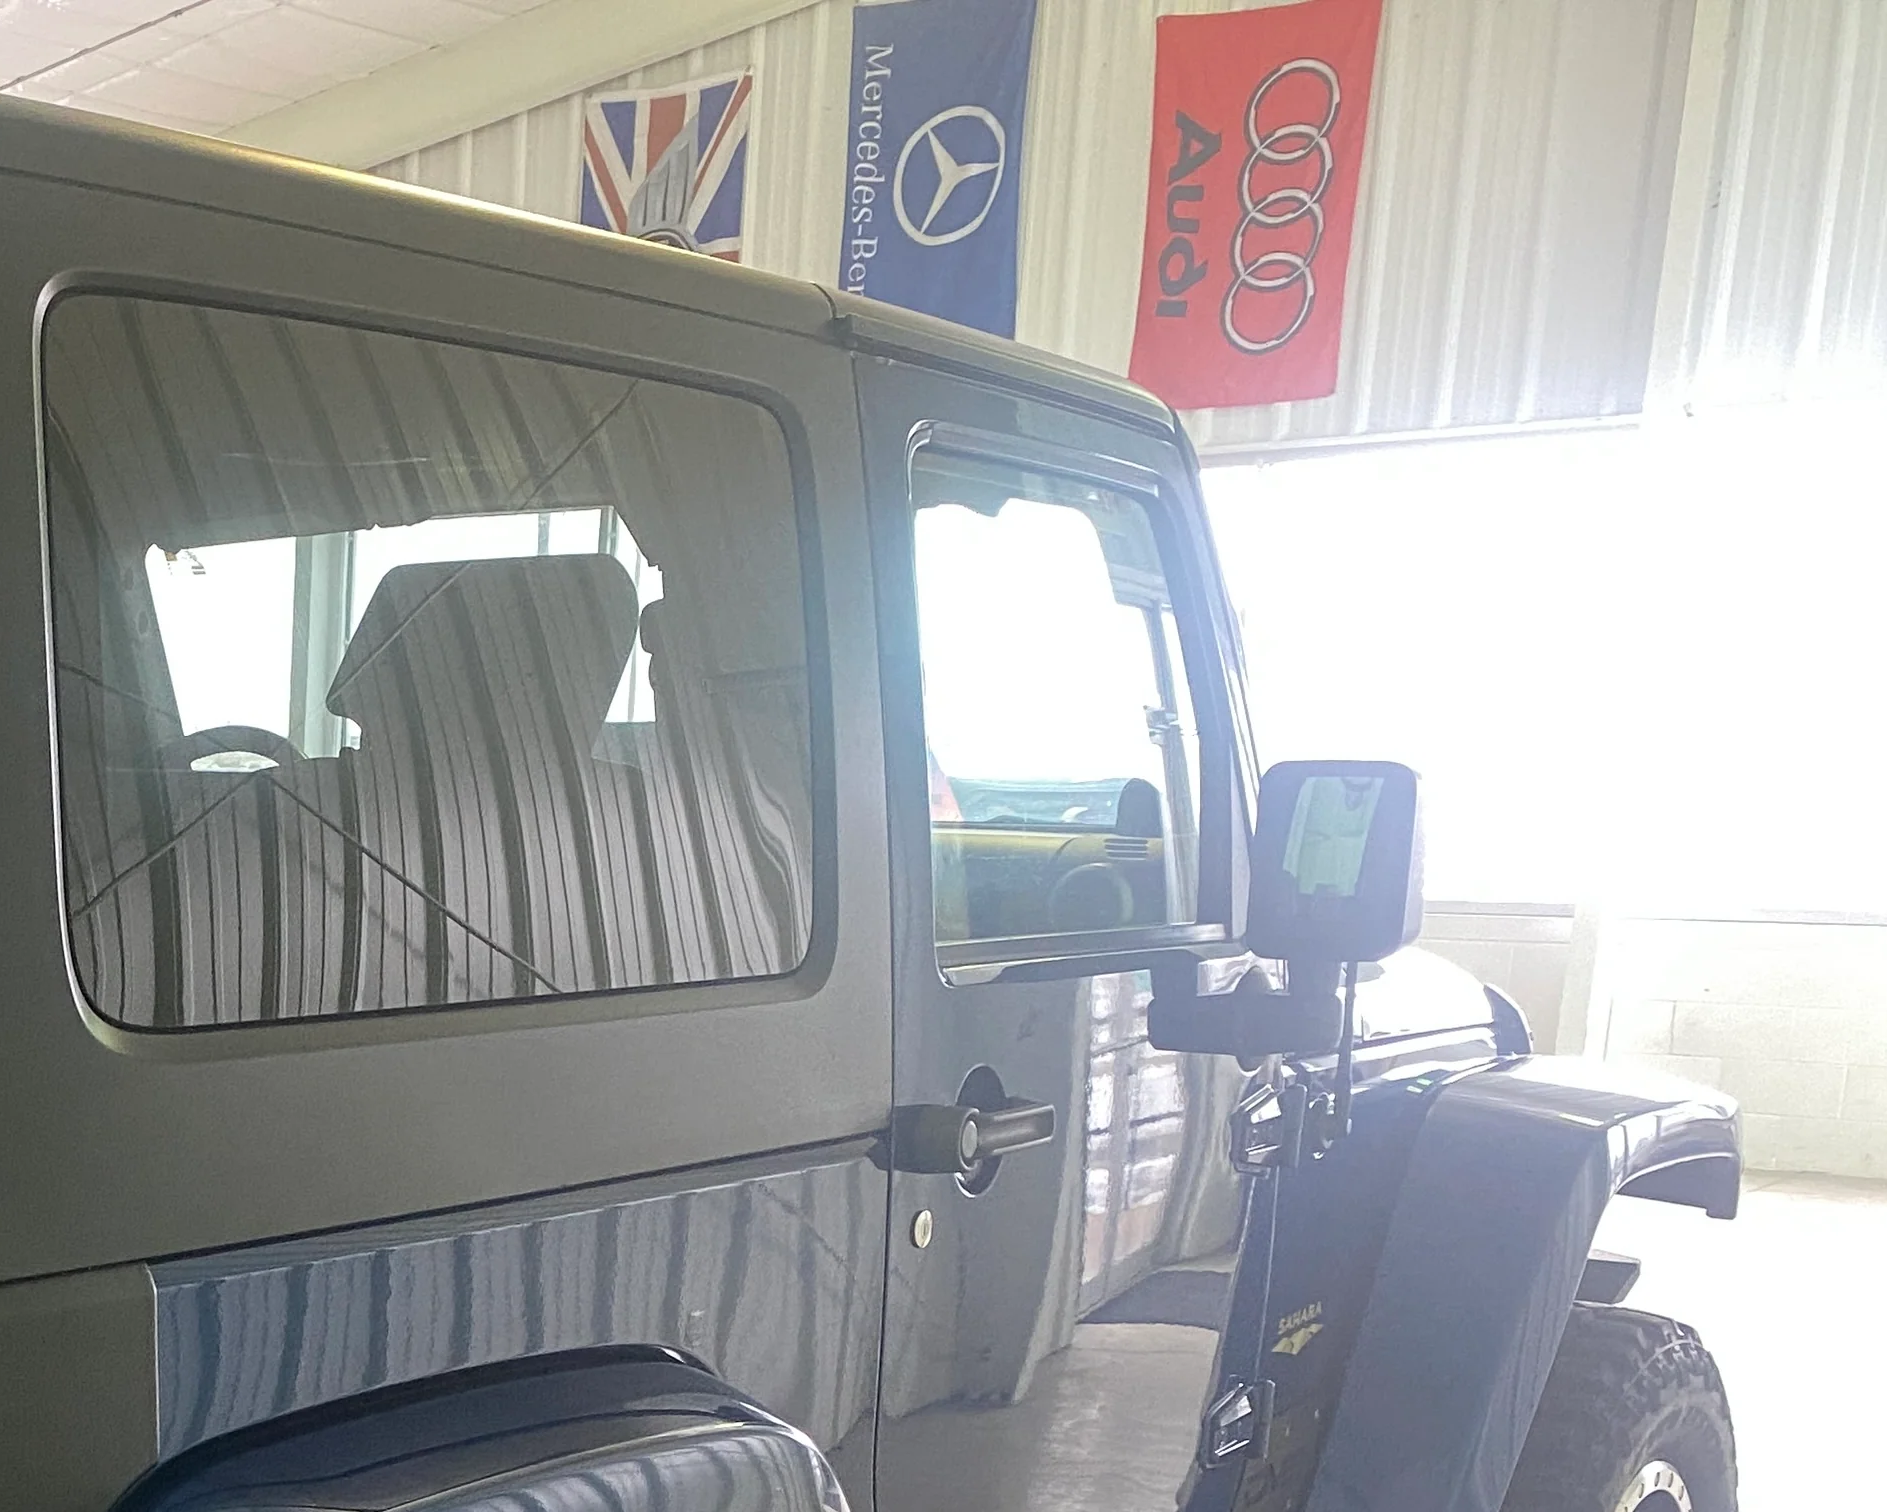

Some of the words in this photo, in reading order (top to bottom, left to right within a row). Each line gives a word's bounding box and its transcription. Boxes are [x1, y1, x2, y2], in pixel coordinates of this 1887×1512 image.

[847, 43, 893, 297] Mercedes-Be
[1155, 109, 1222, 317] Audi
[1278, 1300, 1322, 1335] SAHARA
